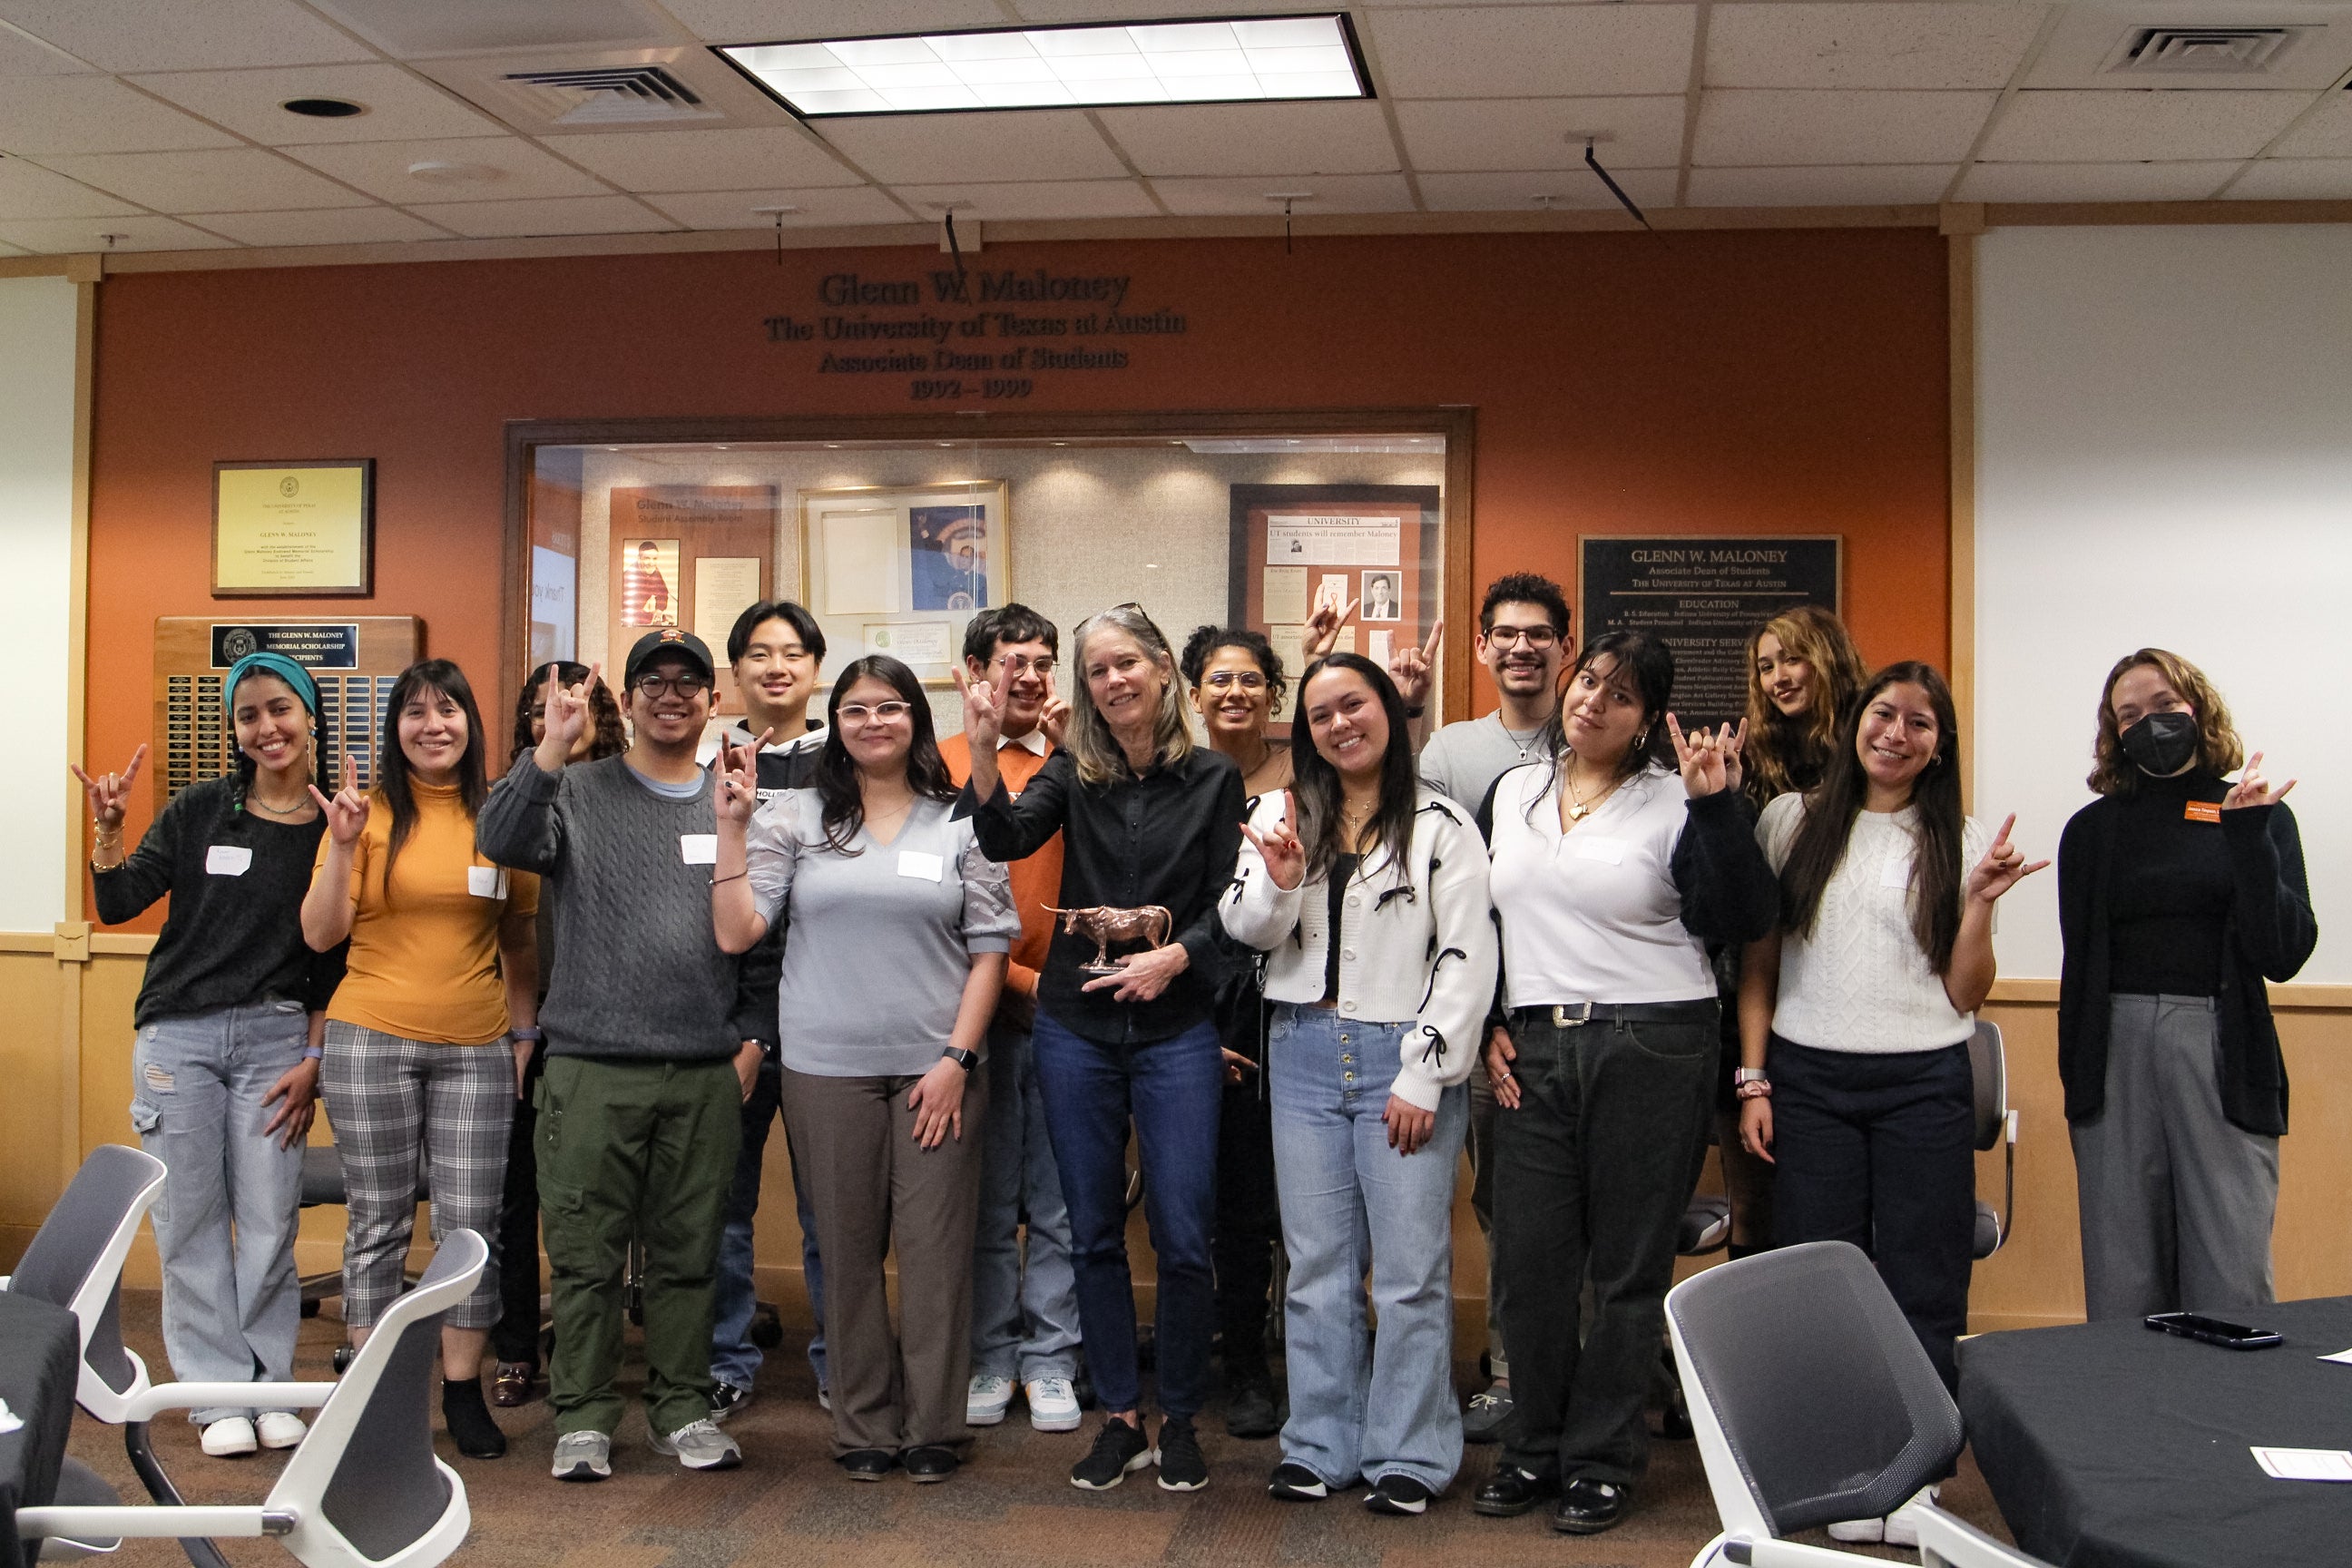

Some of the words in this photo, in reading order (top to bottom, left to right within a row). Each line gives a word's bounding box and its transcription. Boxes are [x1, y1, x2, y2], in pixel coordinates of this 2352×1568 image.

[818, 273, 919, 305] Glenn
[929, 272, 973, 305] W.
[980, 271, 1131, 307] Maloney
[764, 317, 812, 341] The
[821, 314, 952, 344] University
[960, 312, 989, 338] of
[995, 313, 1067, 336] Texas
[1075, 313, 1099, 334] at
[1104, 308, 1185, 334] Austin
[819, 349, 926, 373] Associate
[934, 348, 992, 370] Dean
[1002, 348, 1027, 369] of
[1032, 346, 1127, 368] Students
[638, 499, 673, 509] Glenn
[694, 499, 744, 511] Maloney
[638, 514, 671, 523] Student
[674, 514, 715, 524] Assembly
[718, 514, 743, 523] Room
[1308, 517, 1361, 525] UNIVERSITY
[1283, 530, 1312, 538] students
[1329, 530, 1366, 538] remember
[1368, 530, 1397, 539] Maloney
[1631, 550, 1685, 563] GLENN
[1690, 550, 1706, 563] W.
[1710, 550, 1788, 563] MALONEY
[1649, 566, 1691, 575] Associate
[1694, 567, 1717, 575] Dean
[1719, 566, 1729, 575] of
[1730, 566, 1770, 575] Students
[1651, 579, 1699, 588] UNIVERSITY
[1755, 579, 1787, 588] AUSTIN
[1679, 600, 1740, 609] EDUCATION
[1698, 611, 1729, 619] University
[1712, 619, 1743, 627] University
